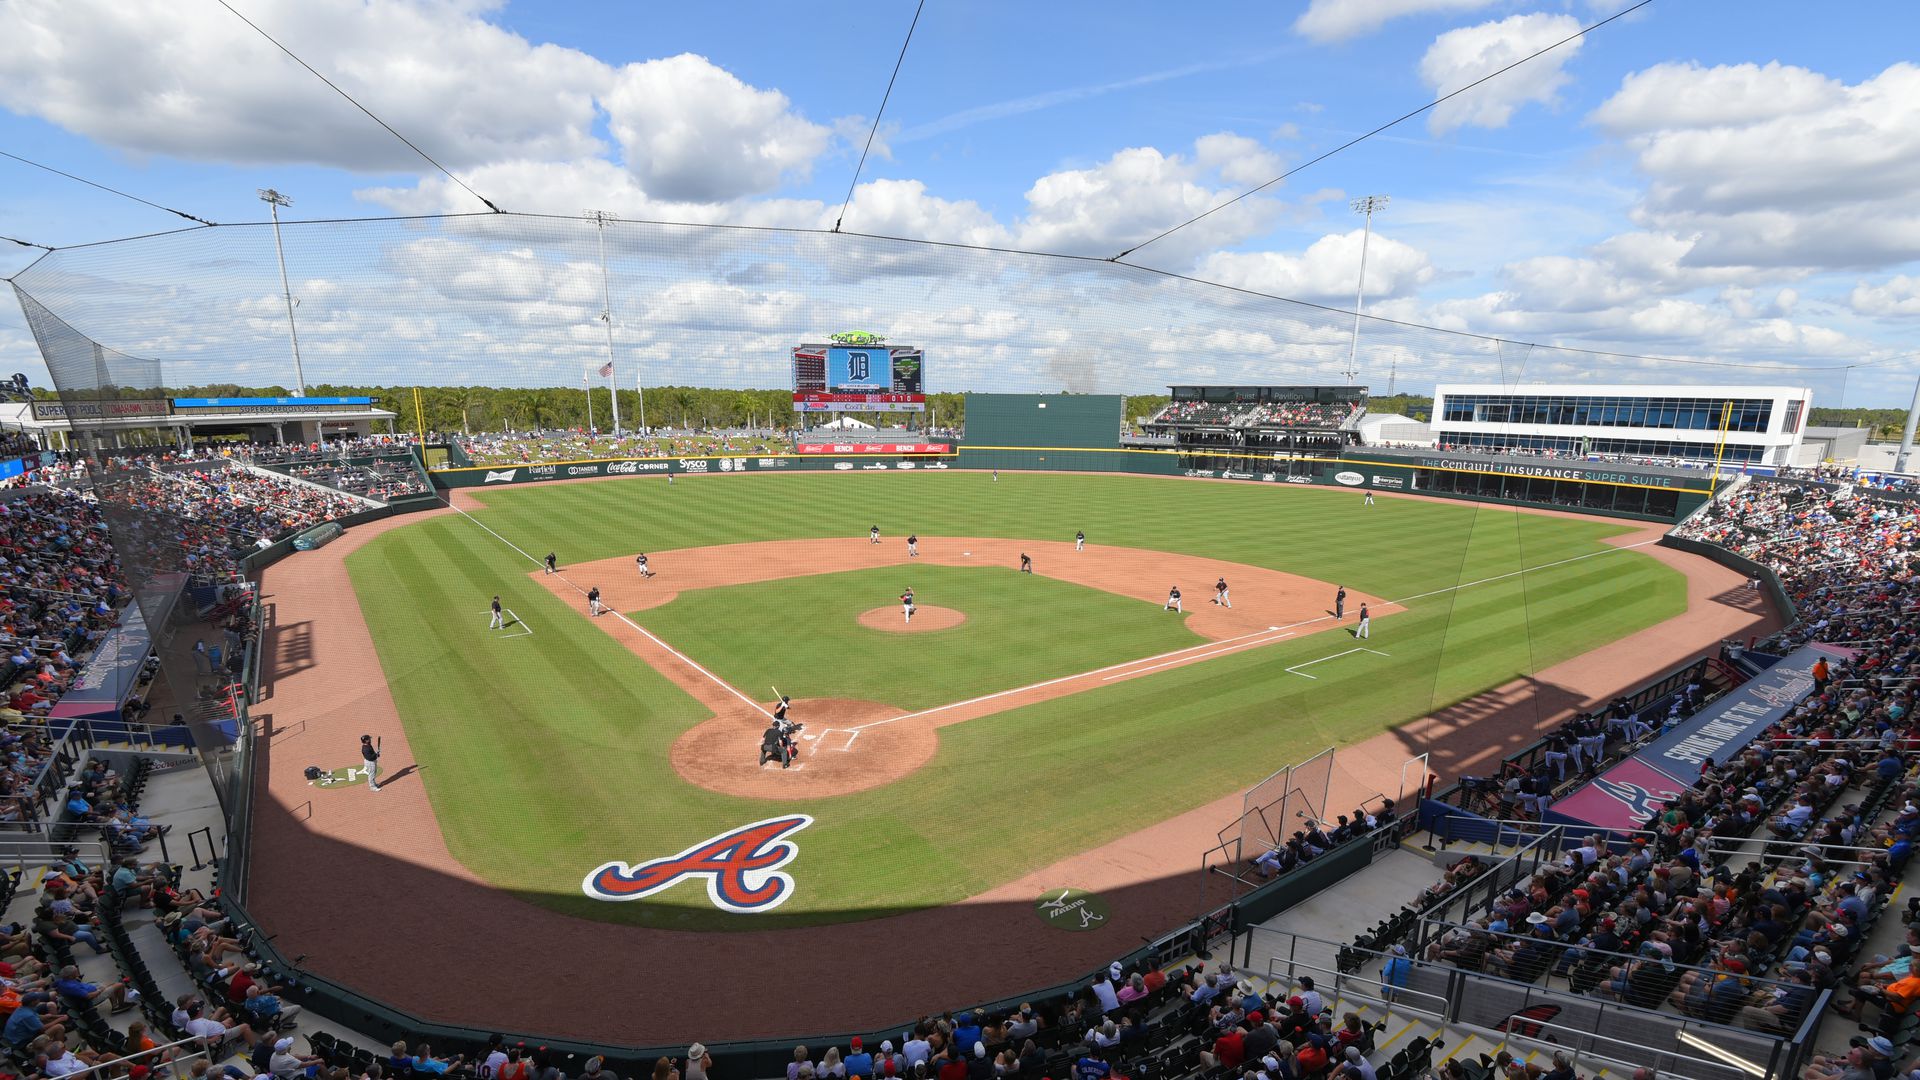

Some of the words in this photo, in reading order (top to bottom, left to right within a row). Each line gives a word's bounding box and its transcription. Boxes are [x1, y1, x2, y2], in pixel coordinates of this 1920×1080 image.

[680, 459, 706, 468] Sysco
[1440, 460, 1494, 472] Centauri
[1504, 466, 1580, 479] INSURANCE
[1586, 473, 1625, 483] SUPER
[1632, 477, 1670, 487] SUITE
[1720, 711, 1756, 725] OF
[1730, 701, 1772, 716] THE
[1698, 719, 1748, 741] HOME
[1663, 734, 1726, 764] SPRING
[582, 813, 814, 914] A
